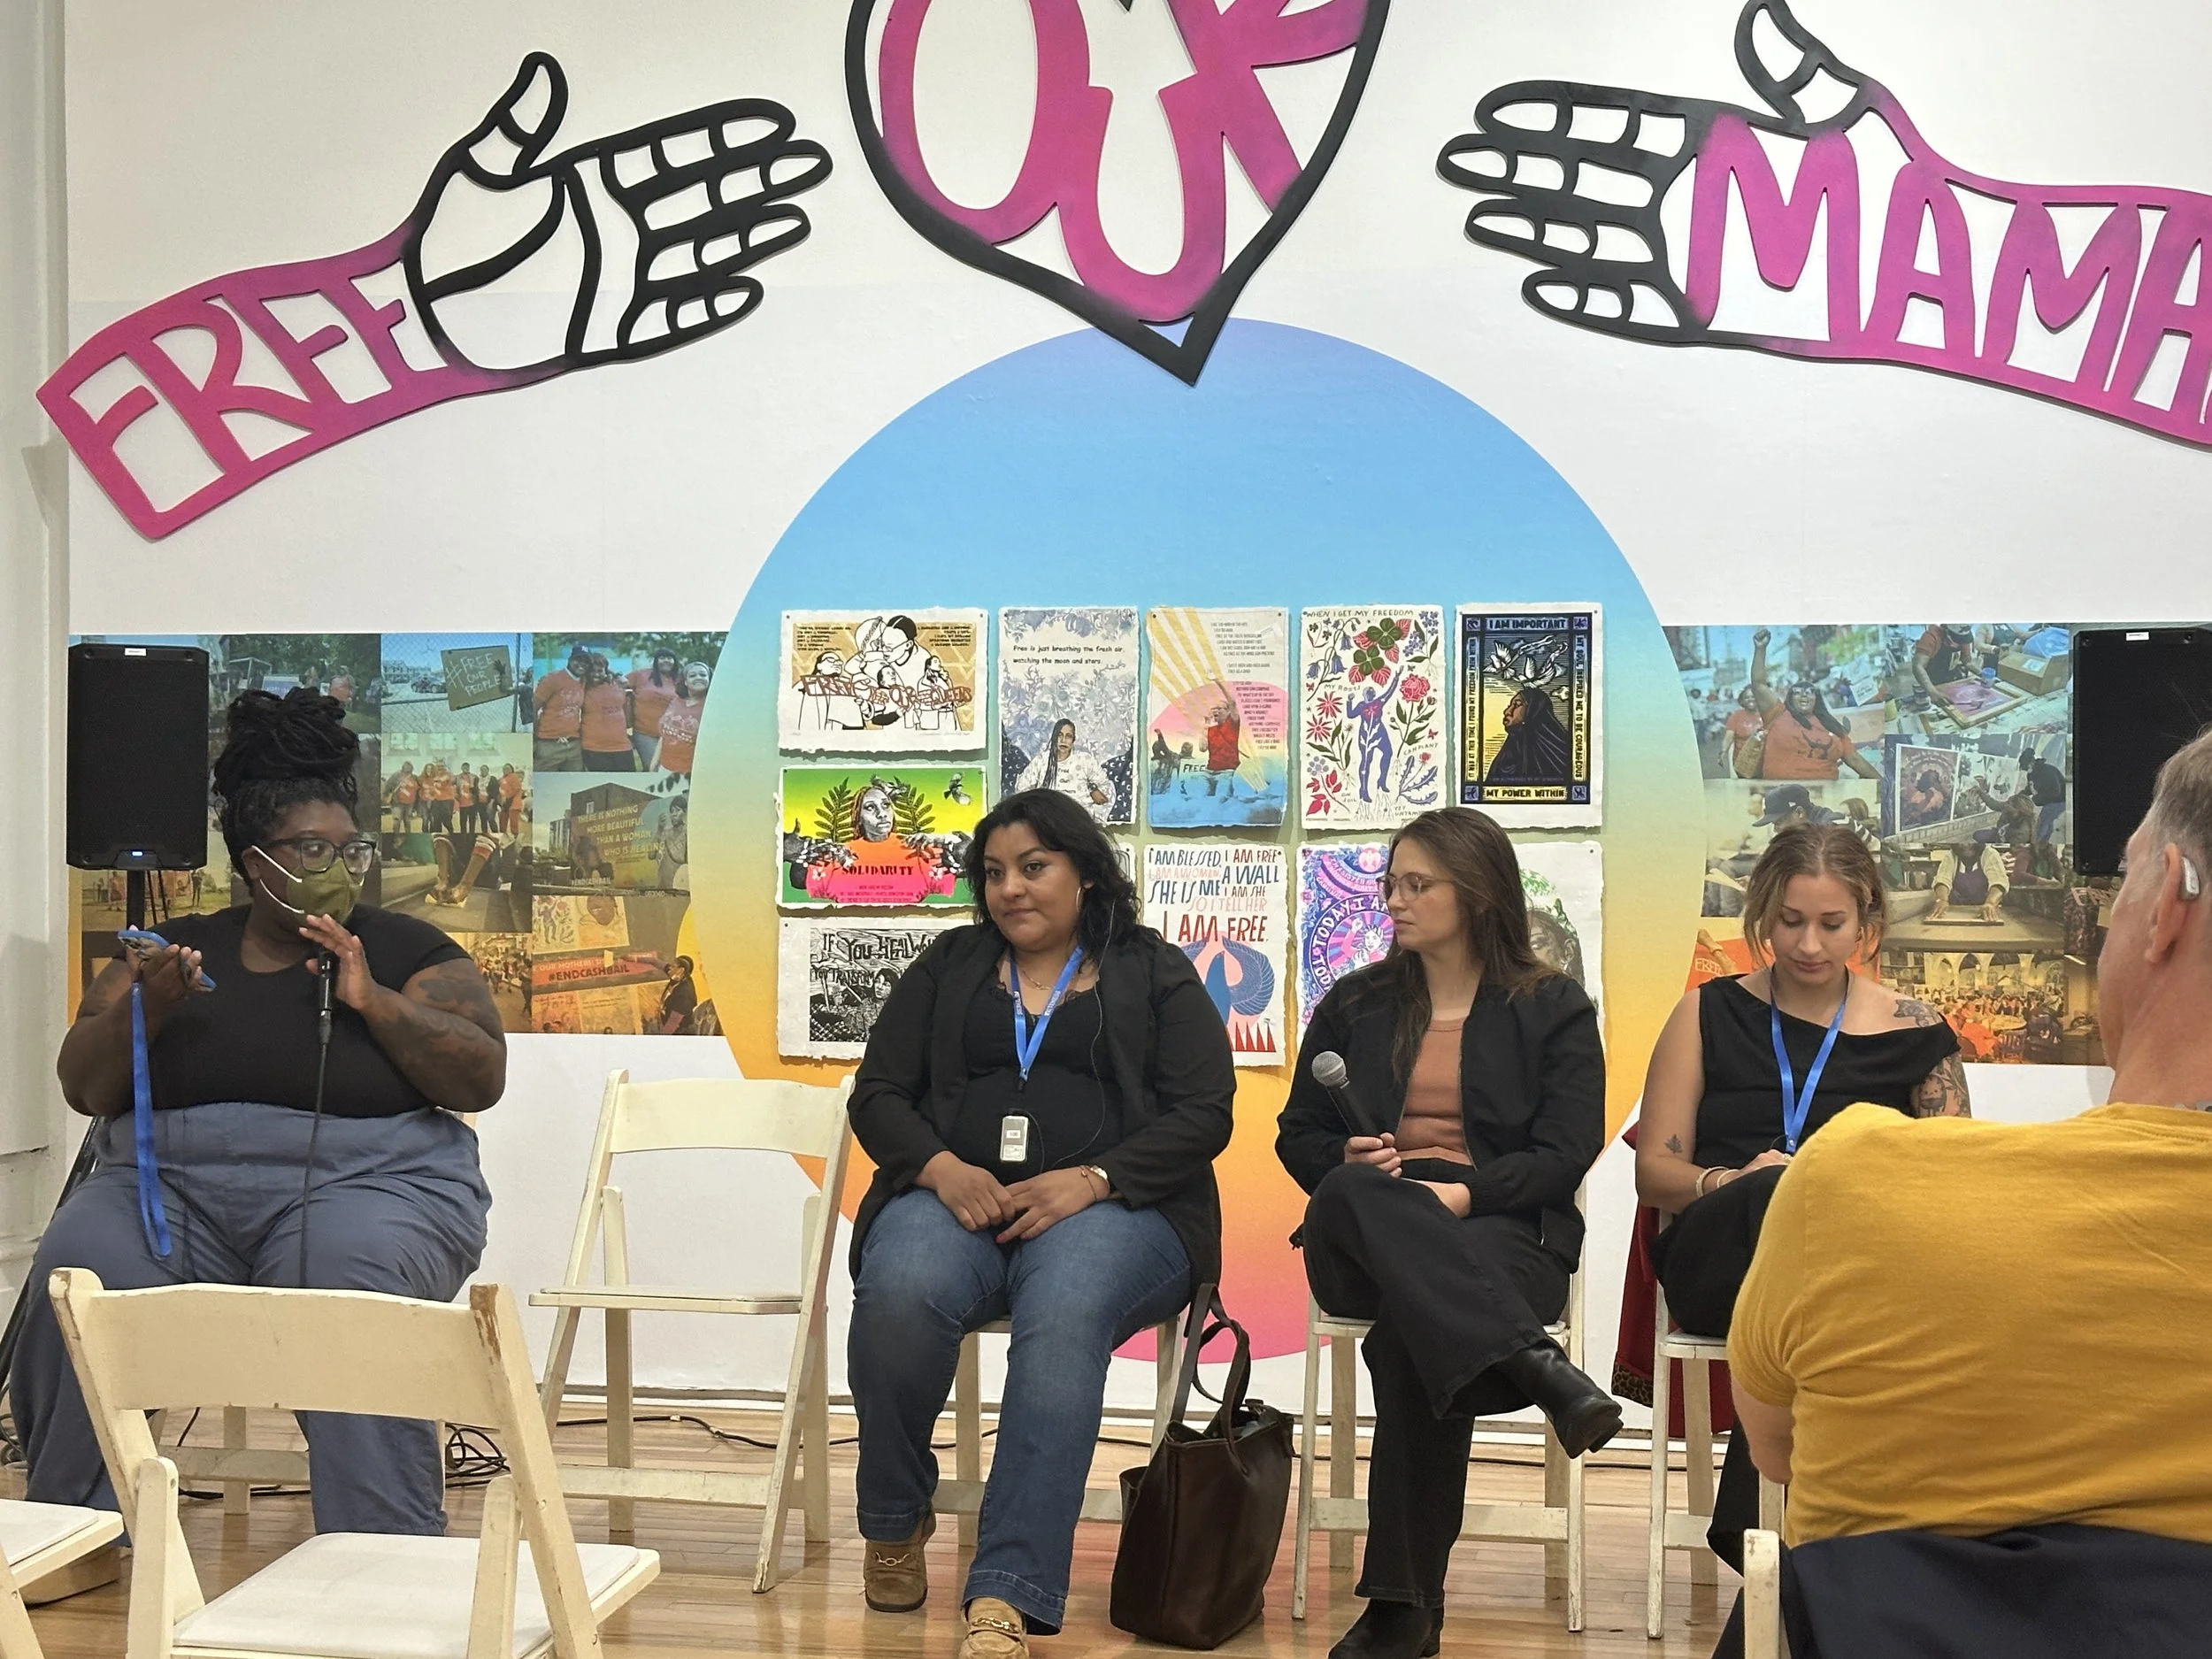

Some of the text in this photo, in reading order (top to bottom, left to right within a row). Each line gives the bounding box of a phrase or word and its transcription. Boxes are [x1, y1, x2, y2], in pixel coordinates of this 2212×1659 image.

[36, 248, 453, 538] FREE
[1495, 619, 1509, 628] AM
[1512, 618, 1566, 628] IMPORTANT
[466, 671, 488, 684] OUR
[465, 674, 501, 697] PEOPLE
[1576, 701, 1586, 710] ME
[1576, 724, 1586, 733] BE
[1403, 746, 1417, 756] CAN
[1576, 734, 1585, 778] COURAGEOUS
[1183, 764, 1206, 773] FREE
[1502, 788, 1532, 797] POWER
[1535, 788, 1564, 797] WITHIN
[578, 813, 597, 824] THERE
[606, 804, 638, 818] NOTHING
[607, 817, 645, 830] BEAUTIFUL
[597, 834, 614, 844] THAN
[604, 847, 620, 856] WHO
[630, 841, 665, 853] HEALING
[1155, 849, 1175, 865] AM
[1177, 849, 1221, 868] BLESSED.
[1225, 849, 1228, 862] I
[1233, 849, 1253, 864] AM
[1256, 849, 1278, 864] FREE
[841, 865, 914, 875] SOLIDARITY
[1222, 864, 1279, 886] A WALL
[1148, 879, 1220, 904] SHE IS ME
[1231, 886, 1248, 897] AM
[1249, 885, 1267, 897] SHE
[1187, 896, 1208, 912] SO
[1218, 897, 1242, 912] TELL
[1245, 897, 1268, 912] HER
[1178, 914, 1218, 942] AM
[1312, 899, 1352, 948] TODAY
[1353, 897, 1365, 910] I
[822, 933, 836, 952] IF
[844, 938, 873, 963] YOU
[877, 934, 913, 961] HEAL
[549, 964, 631, 982] #ENDCASHBAIL
